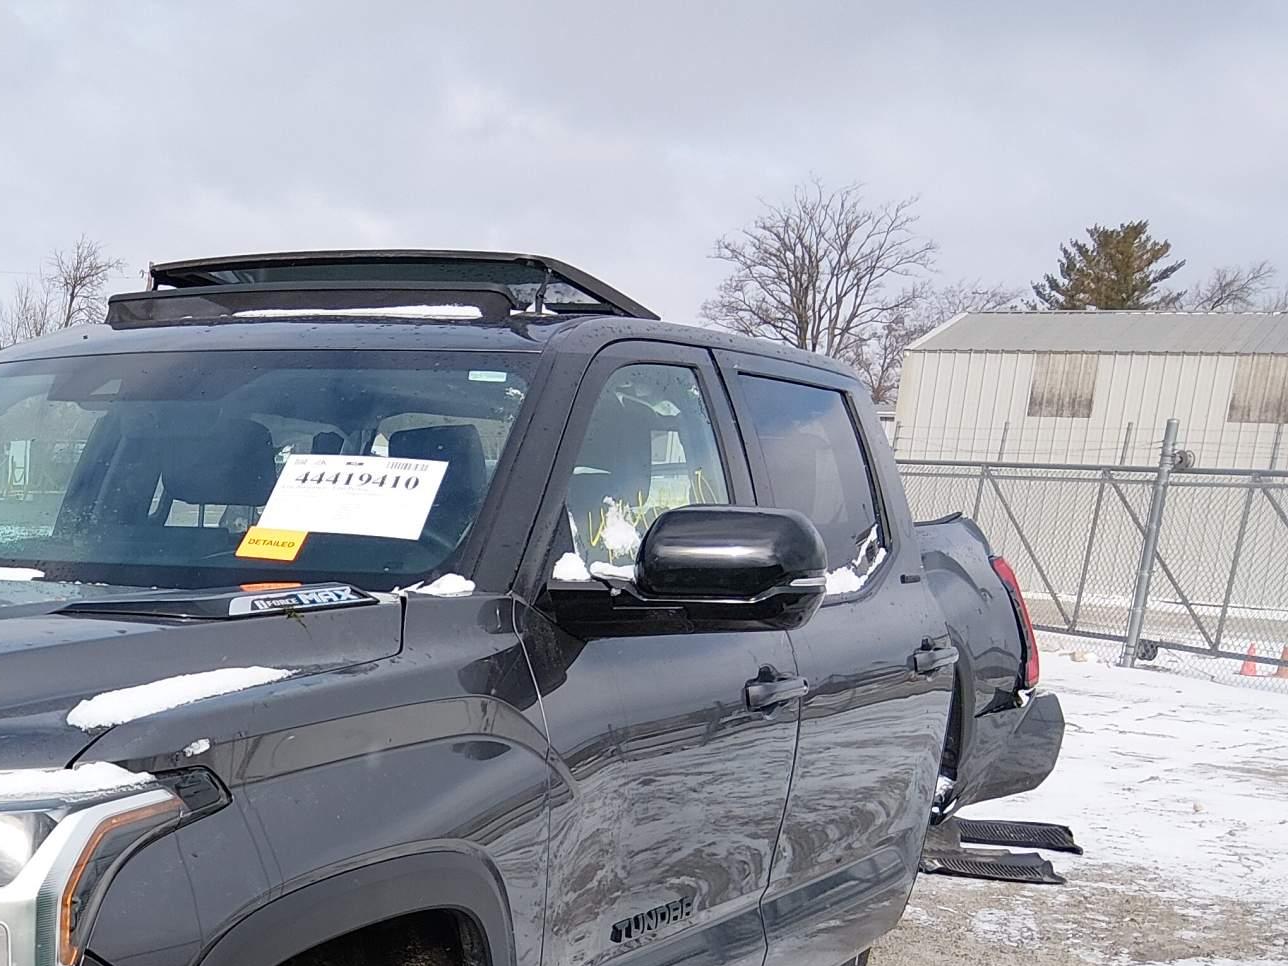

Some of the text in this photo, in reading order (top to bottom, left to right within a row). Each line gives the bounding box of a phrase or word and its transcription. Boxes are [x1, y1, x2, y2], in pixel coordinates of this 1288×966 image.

[295, 470, 420, 491] 44419410
[247, 537, 296, 550] DETAILED
[297, 586, 359, 605] MAX
